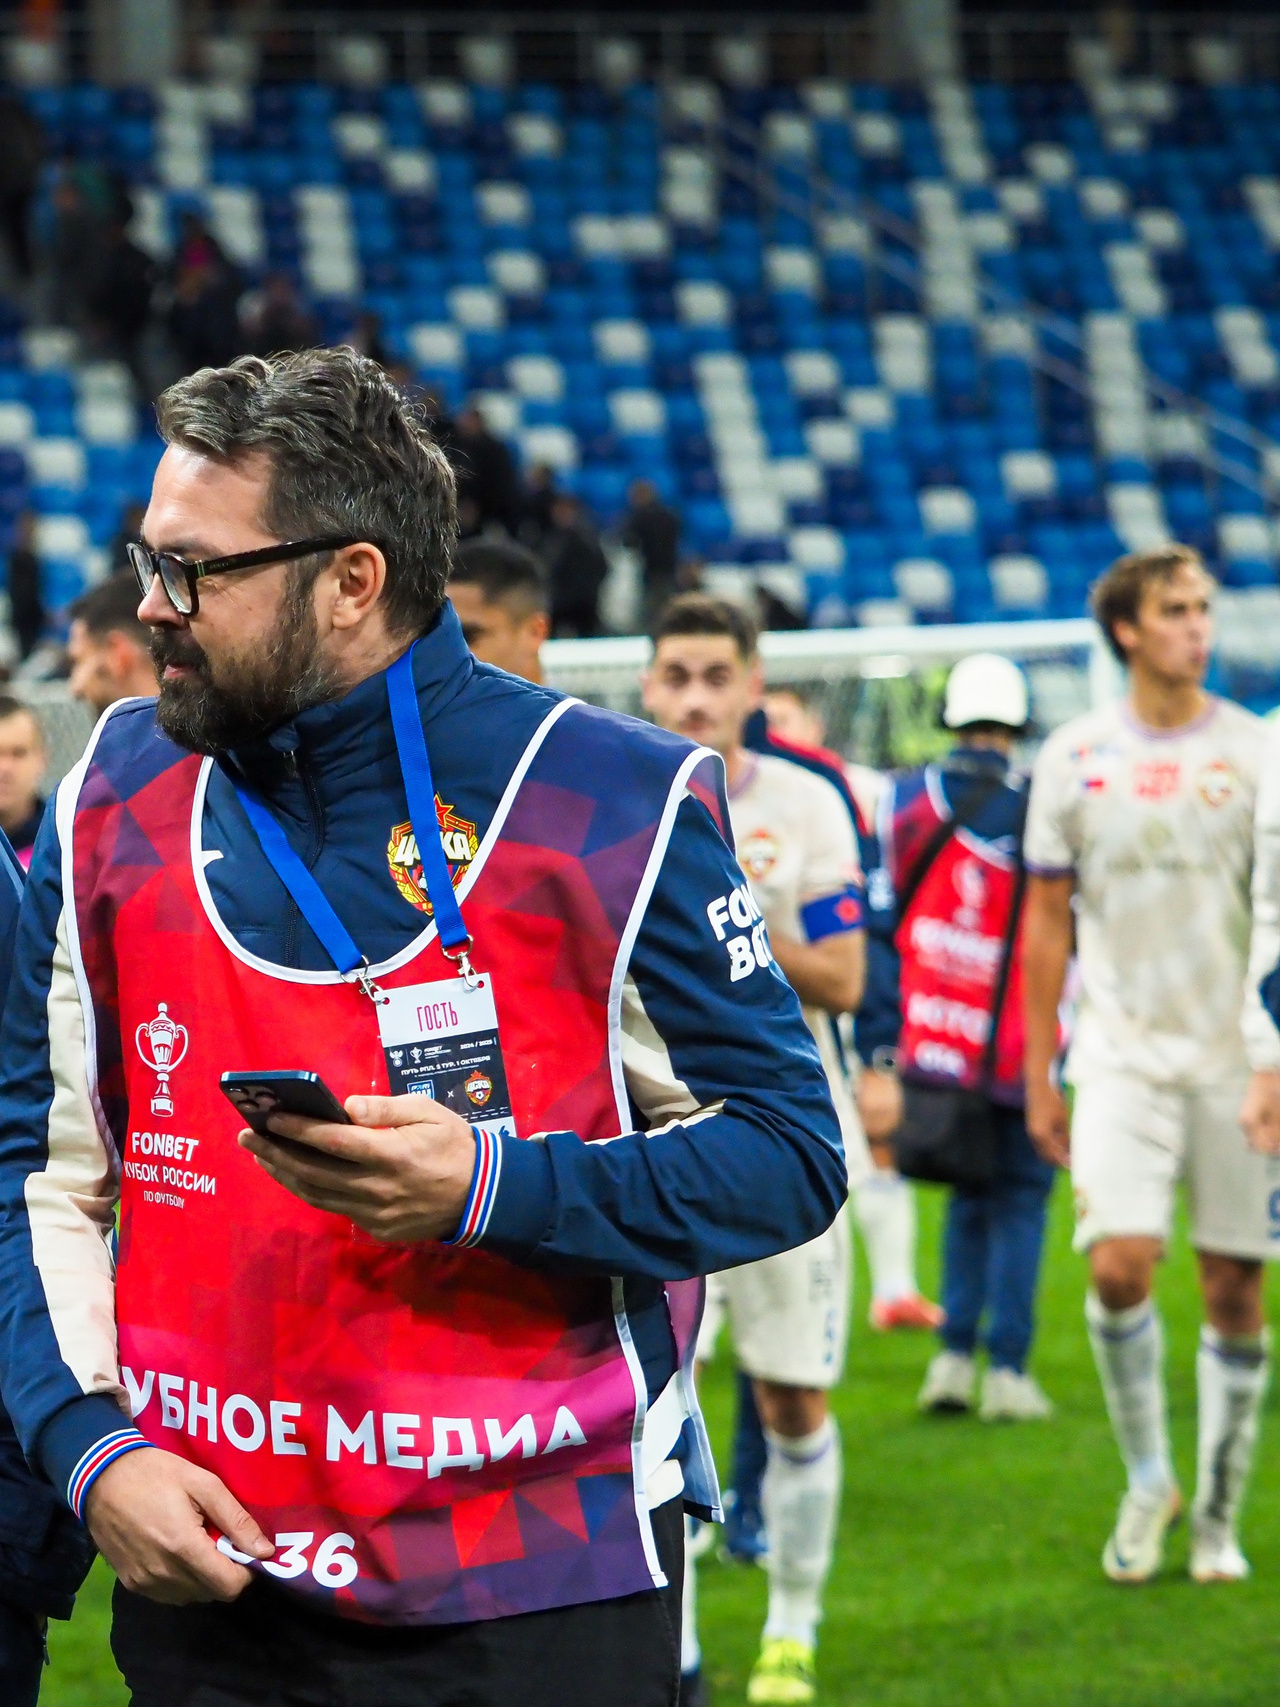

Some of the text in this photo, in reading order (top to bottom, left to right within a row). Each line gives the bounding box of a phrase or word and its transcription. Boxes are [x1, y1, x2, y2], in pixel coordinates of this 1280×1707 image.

[392, 831, 473, 866] ЦКА
[416, 1001, 459, 1032] ГОСТЬ
[401, 1068, 419, 1076] ПУТЬ
[132, 1131, 199, 1162] FONBET
[123, 1160, 216, 1196] КУБОК РОССИИ
[143, 1190, 185, 1210] ПО ФУТБОЛУ
[121, 1366, 588, 1479] УБНОЕ МЕДИА
[217, 1532, 359, 1588] 36
